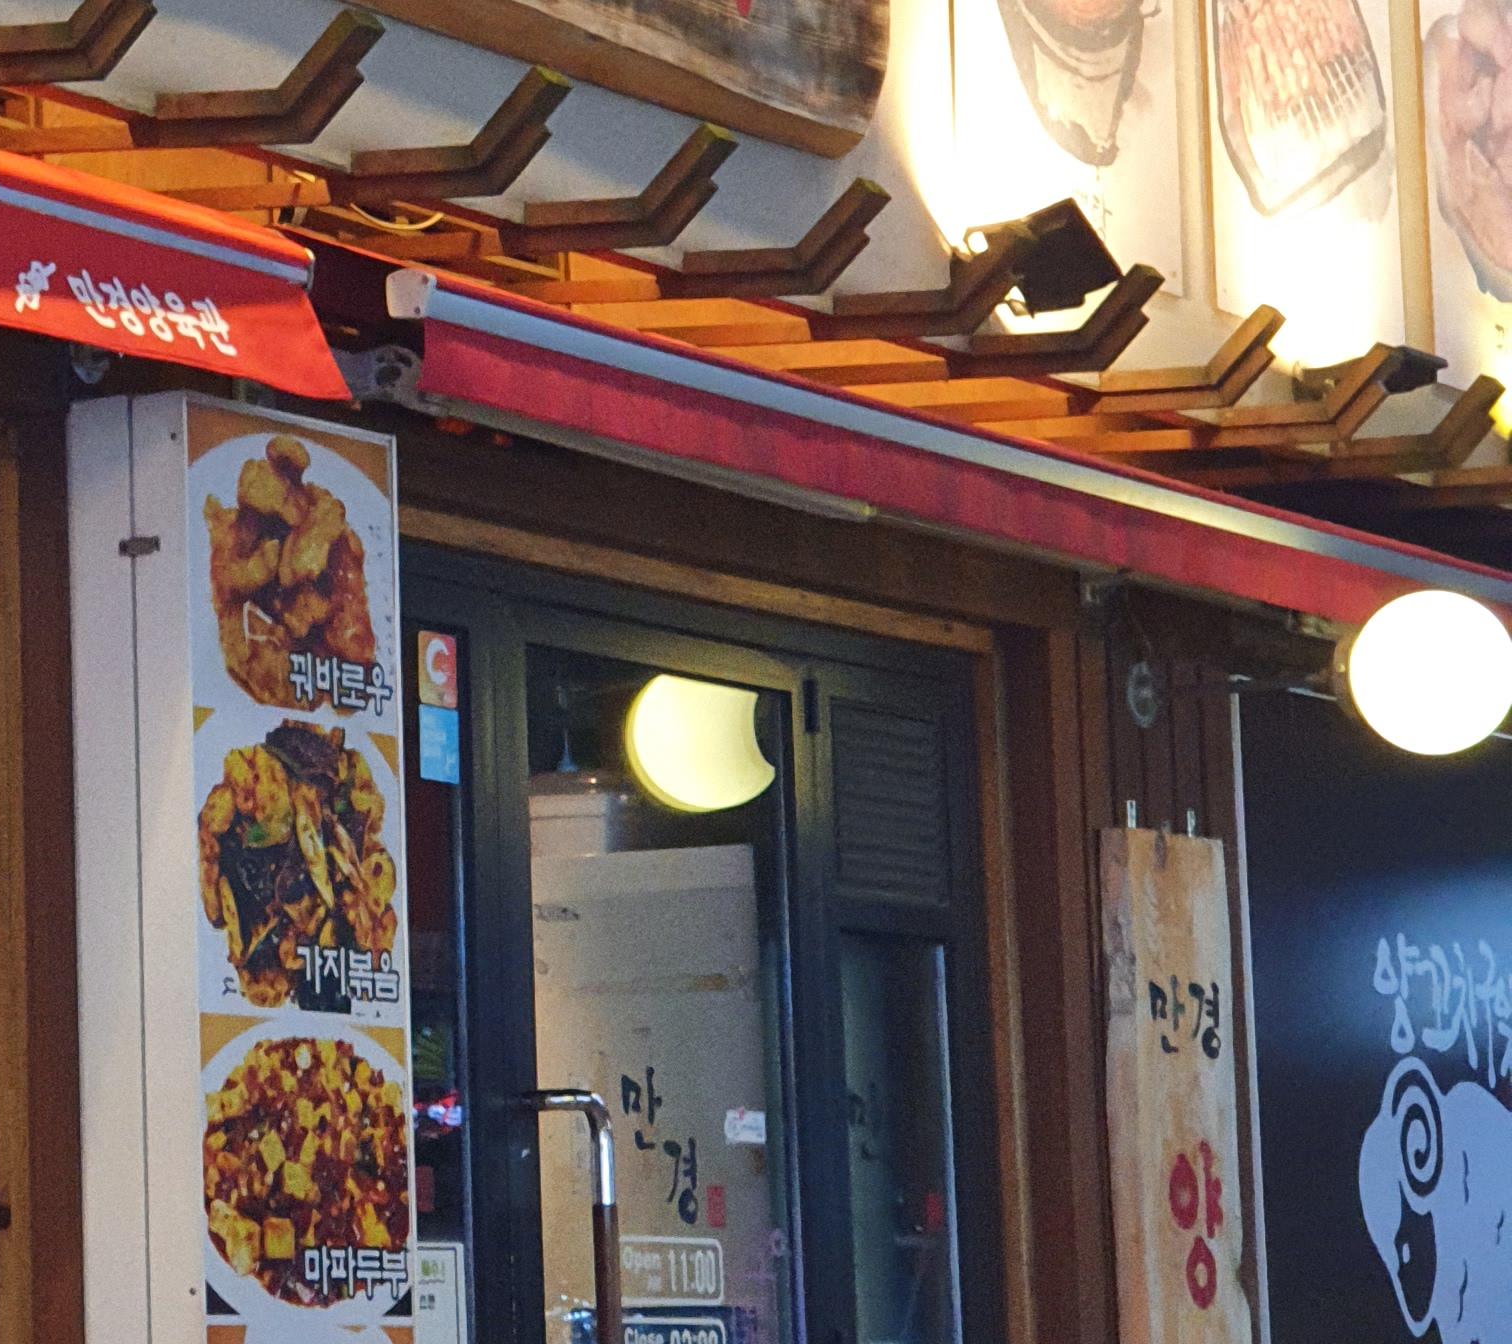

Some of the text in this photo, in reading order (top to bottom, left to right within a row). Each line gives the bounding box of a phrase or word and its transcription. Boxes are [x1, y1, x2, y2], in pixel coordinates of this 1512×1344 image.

[289, 650, 394, 716] 꿔바로우
[296, 944, 400, 1002] 가지볶음
[1149, 974, 1222, 1059] 만경
[621, 1066, 699, 1224] 만경
[304, 1246, 408, 1300] 마파두부
